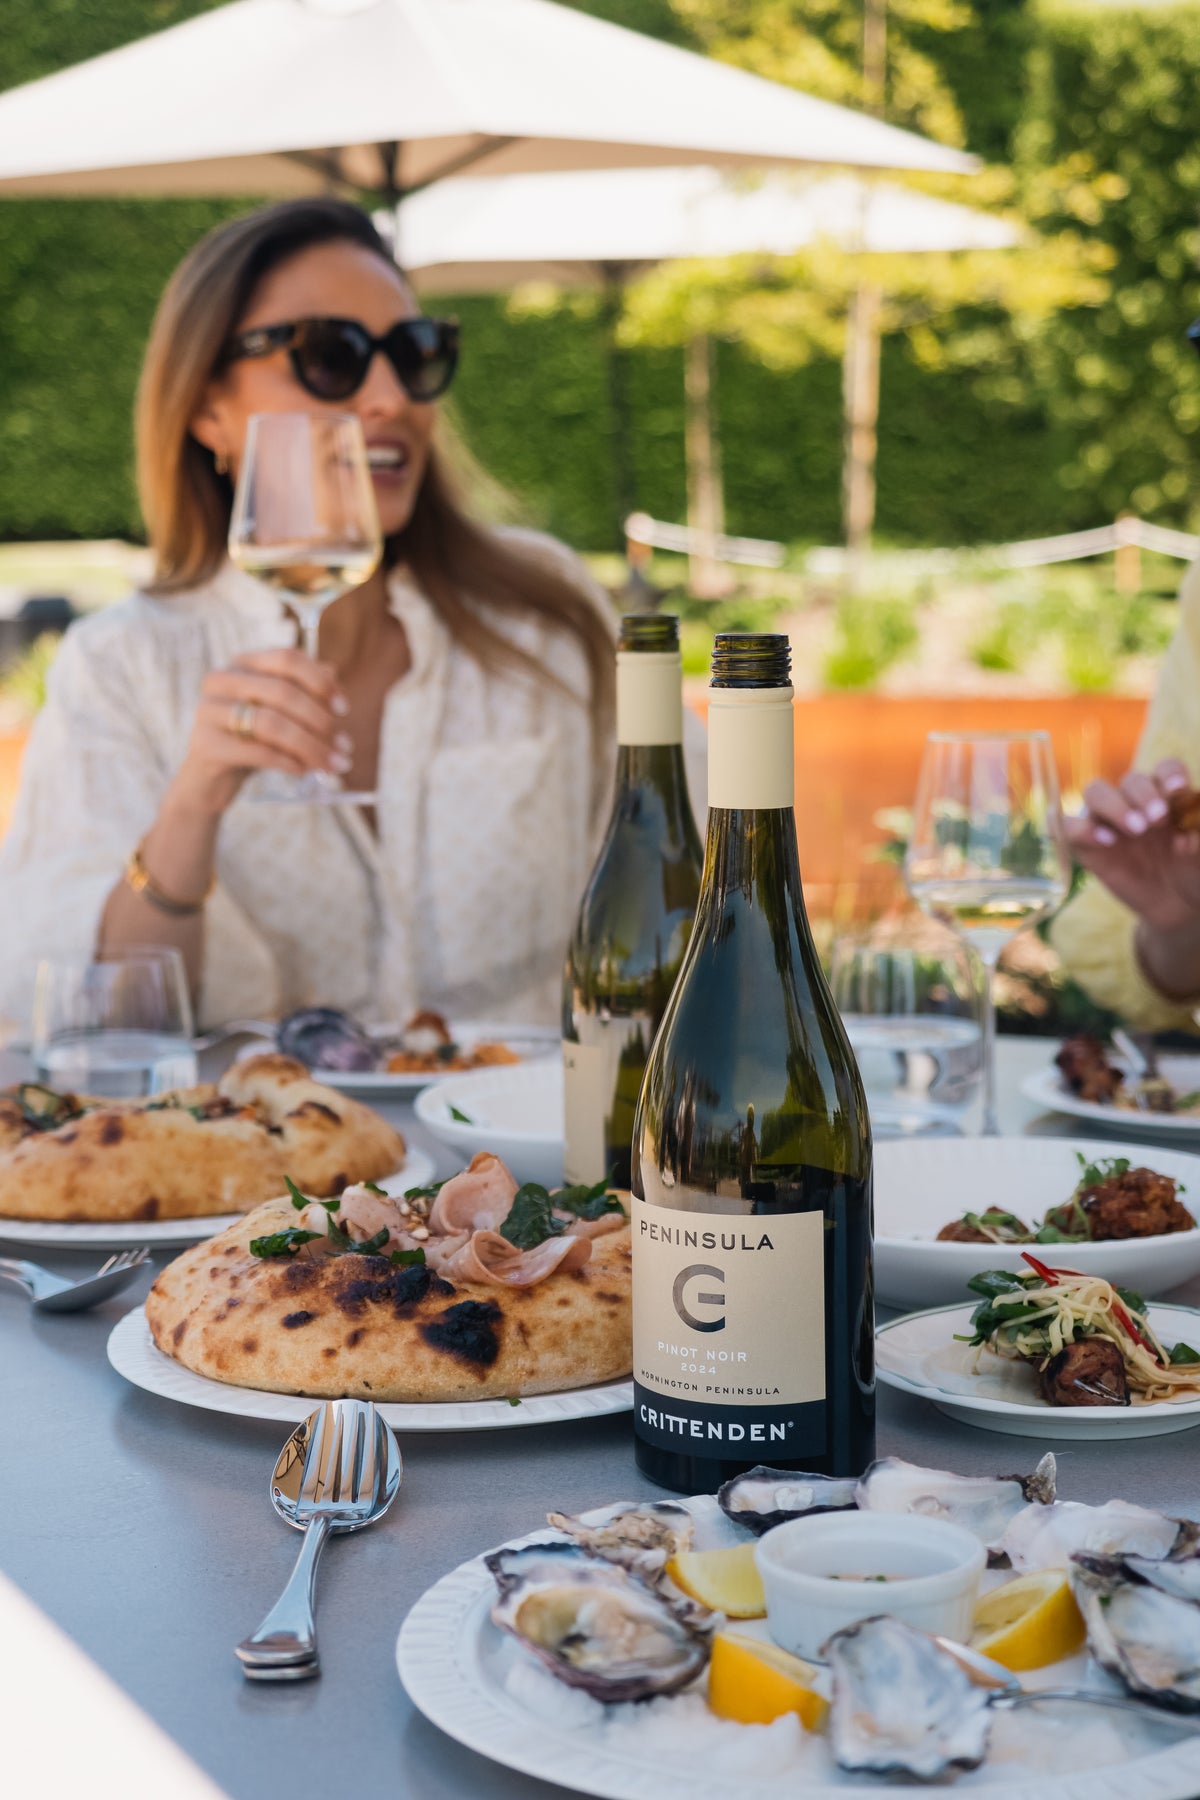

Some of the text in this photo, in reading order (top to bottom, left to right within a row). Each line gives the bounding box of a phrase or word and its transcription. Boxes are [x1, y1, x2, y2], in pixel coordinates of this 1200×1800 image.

[641, 1219, 774, 1250] PENINSULA
[658, 1341, 747, 1363] PINOT NOIR
[681, 1362, 716, 1374] 2024
[641, 1369, 780, 1395] MORNINGTON PENINSULA
